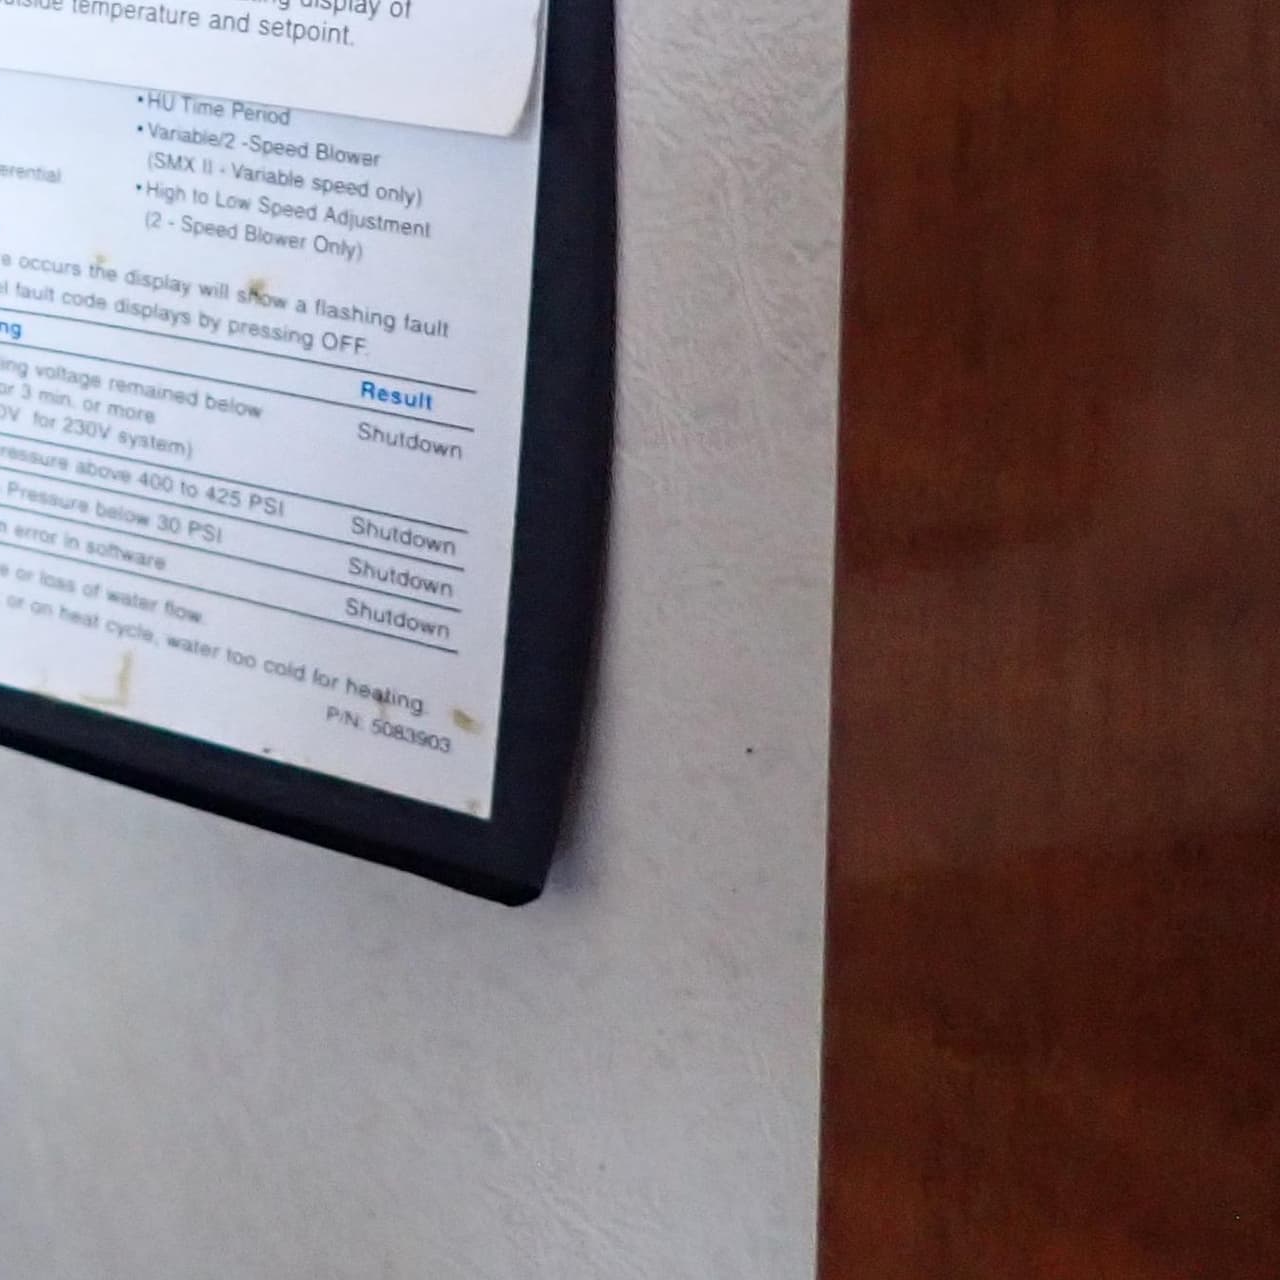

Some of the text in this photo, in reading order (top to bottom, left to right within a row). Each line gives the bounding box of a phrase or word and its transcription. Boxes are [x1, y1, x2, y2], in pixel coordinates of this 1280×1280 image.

[207, 12, 251, 34] and
[257, 18, 357, 46] setpoint.
[146, 91, 292, 126] HU Time Period
[145, 181, 432, 238] High to Low Speed Adjustment
[359, 381, 434, 411] Result
[356, 423, 464, 460] Shutdown
[350, 516, 457, 555] Shutdown
[347, 557, 455, 597] Shutdown
[344, 598, 451, 639] Shutdown
